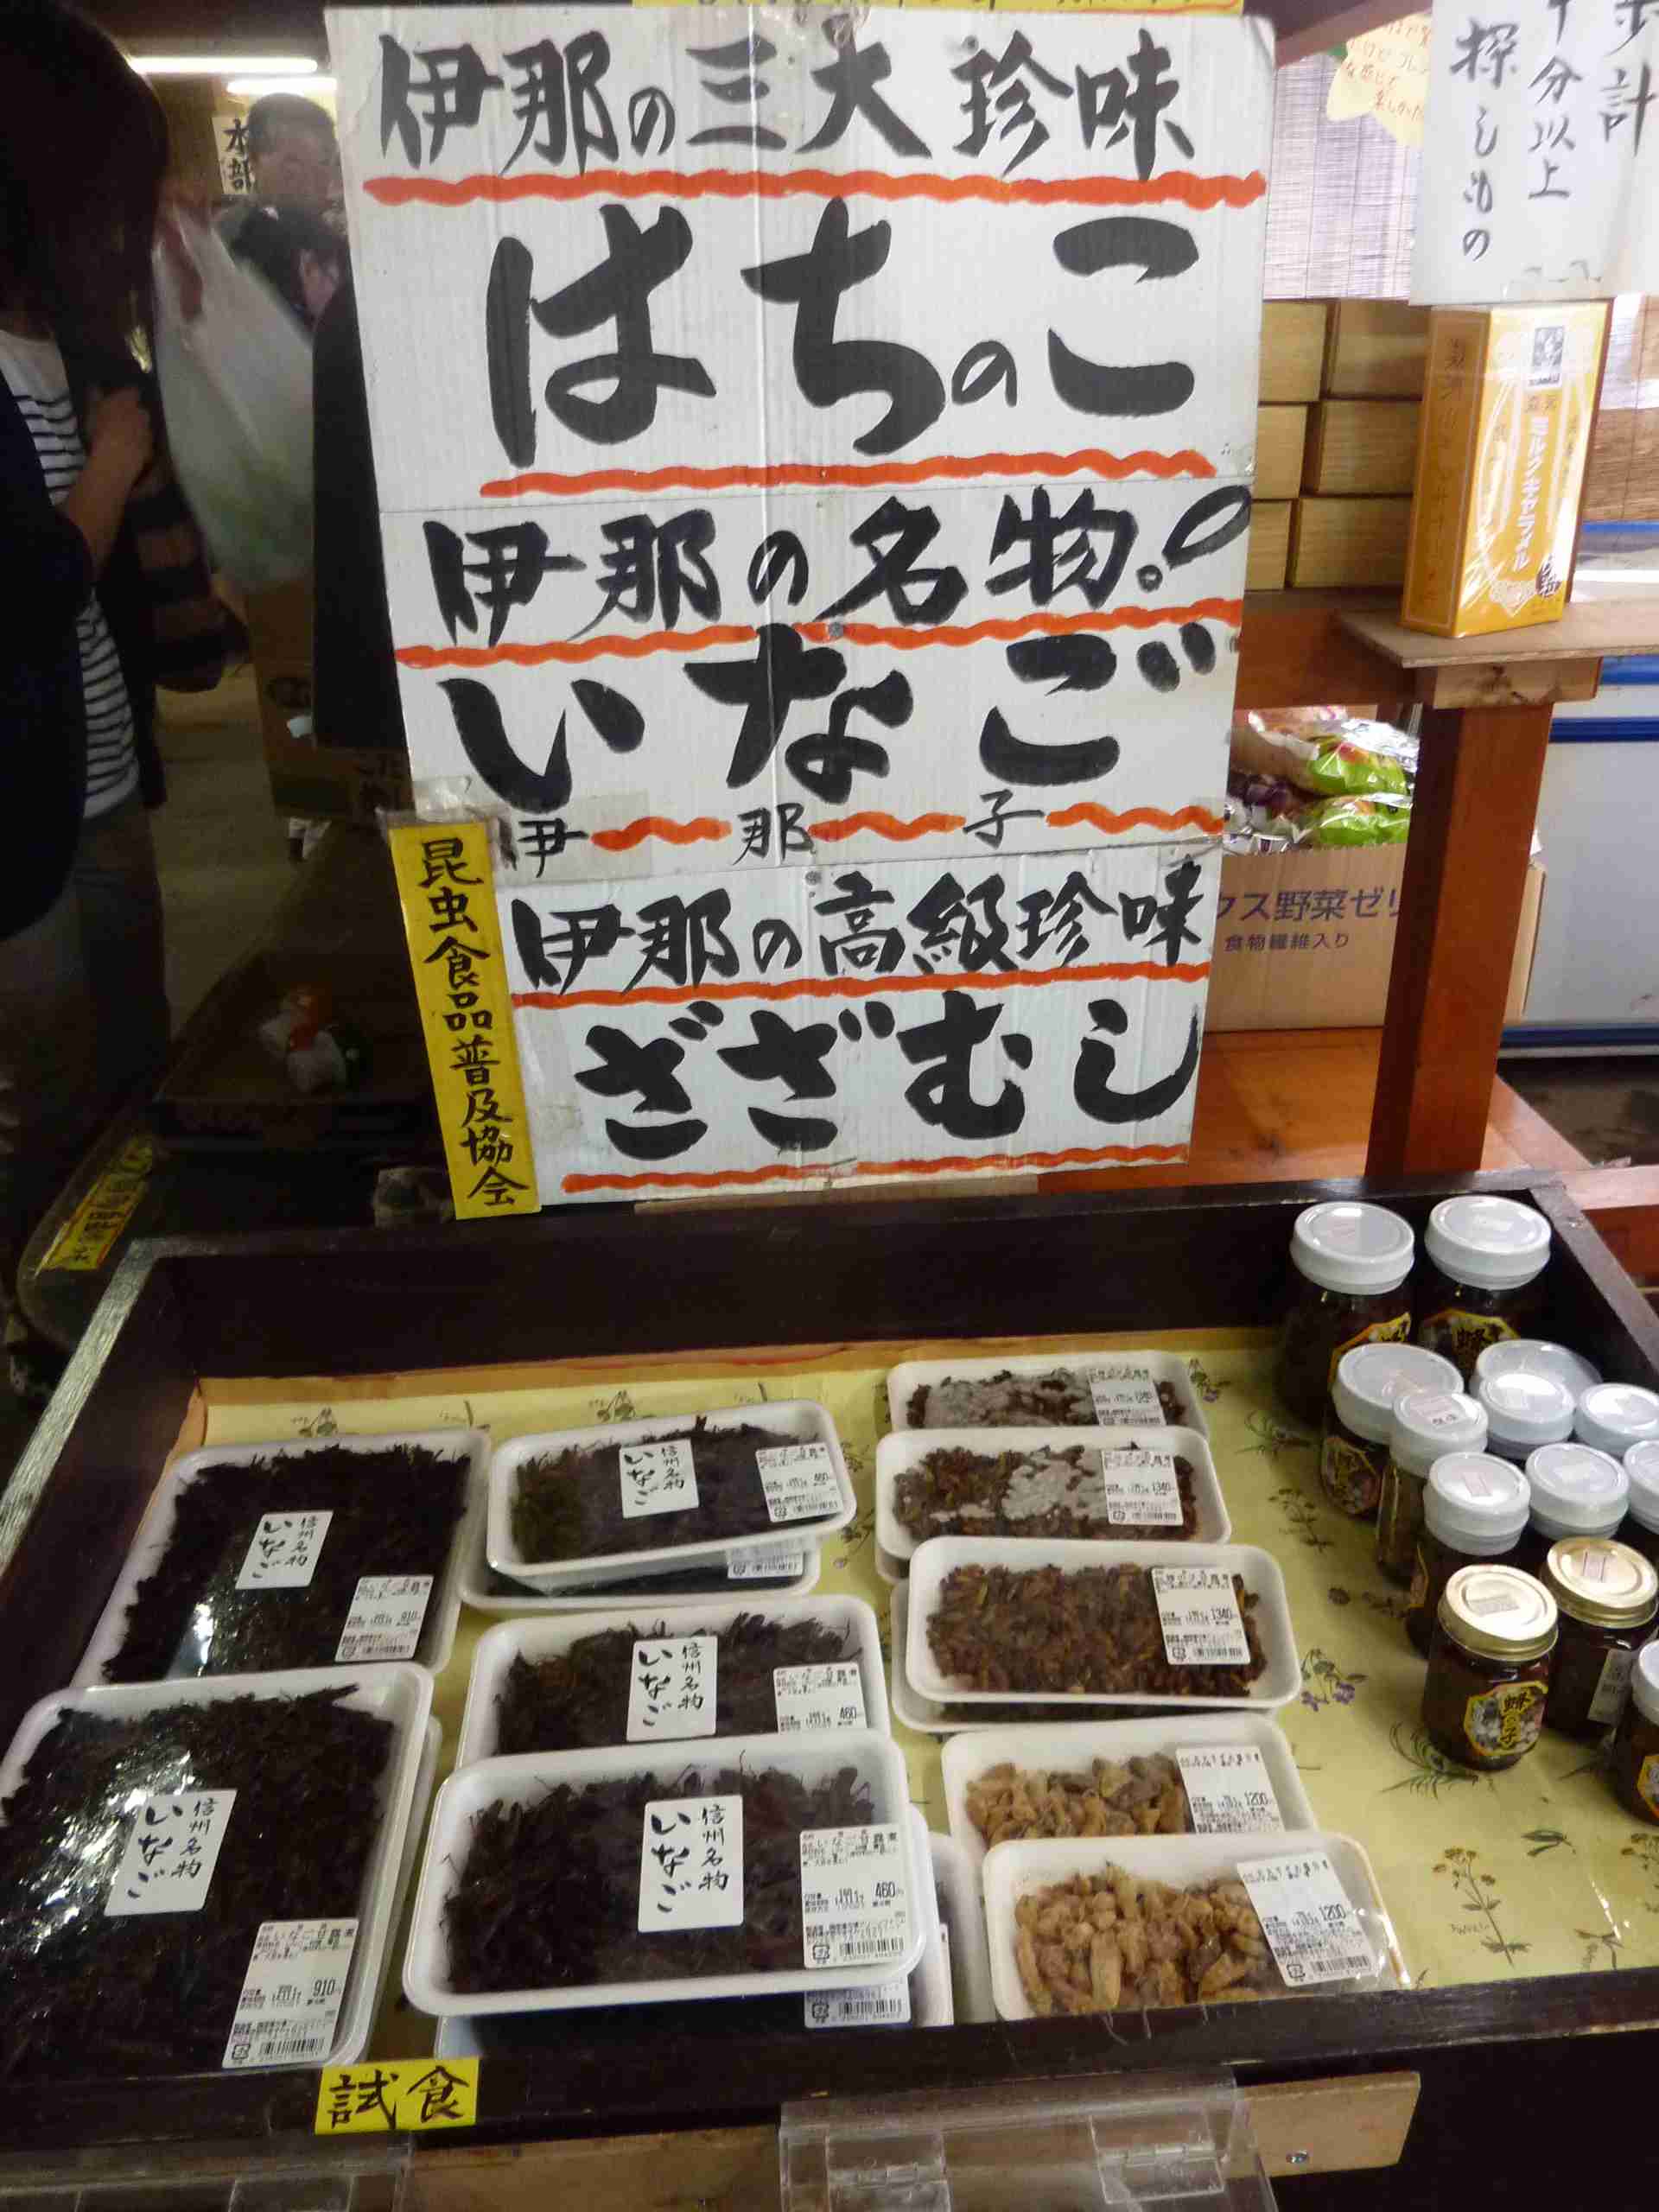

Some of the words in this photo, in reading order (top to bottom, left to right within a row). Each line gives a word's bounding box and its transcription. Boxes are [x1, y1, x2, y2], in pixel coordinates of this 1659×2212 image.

[380, 29, 1195, 180] 伊那の三大珍味
[486, 197, 1199, 467] はちのこ
[437, 624, 1217, 812] いなご
[512, 855, 1201, 994] 伊那の高級珍味
[418, 836, 530, 1207] 昆虫食品普及協会
[575, 990, 1199, 1161] ざざむし
[132, 1804, 183, 1899] いなご
[171, 1798, 218, 1878] 信州名物
[650, 1812, 692, 1913] いなご
[697, 1804, 729, 1891] 信州名物
[313, 1980, 336, 1997] 910
[327, 2065, 469, 2129] 試食
